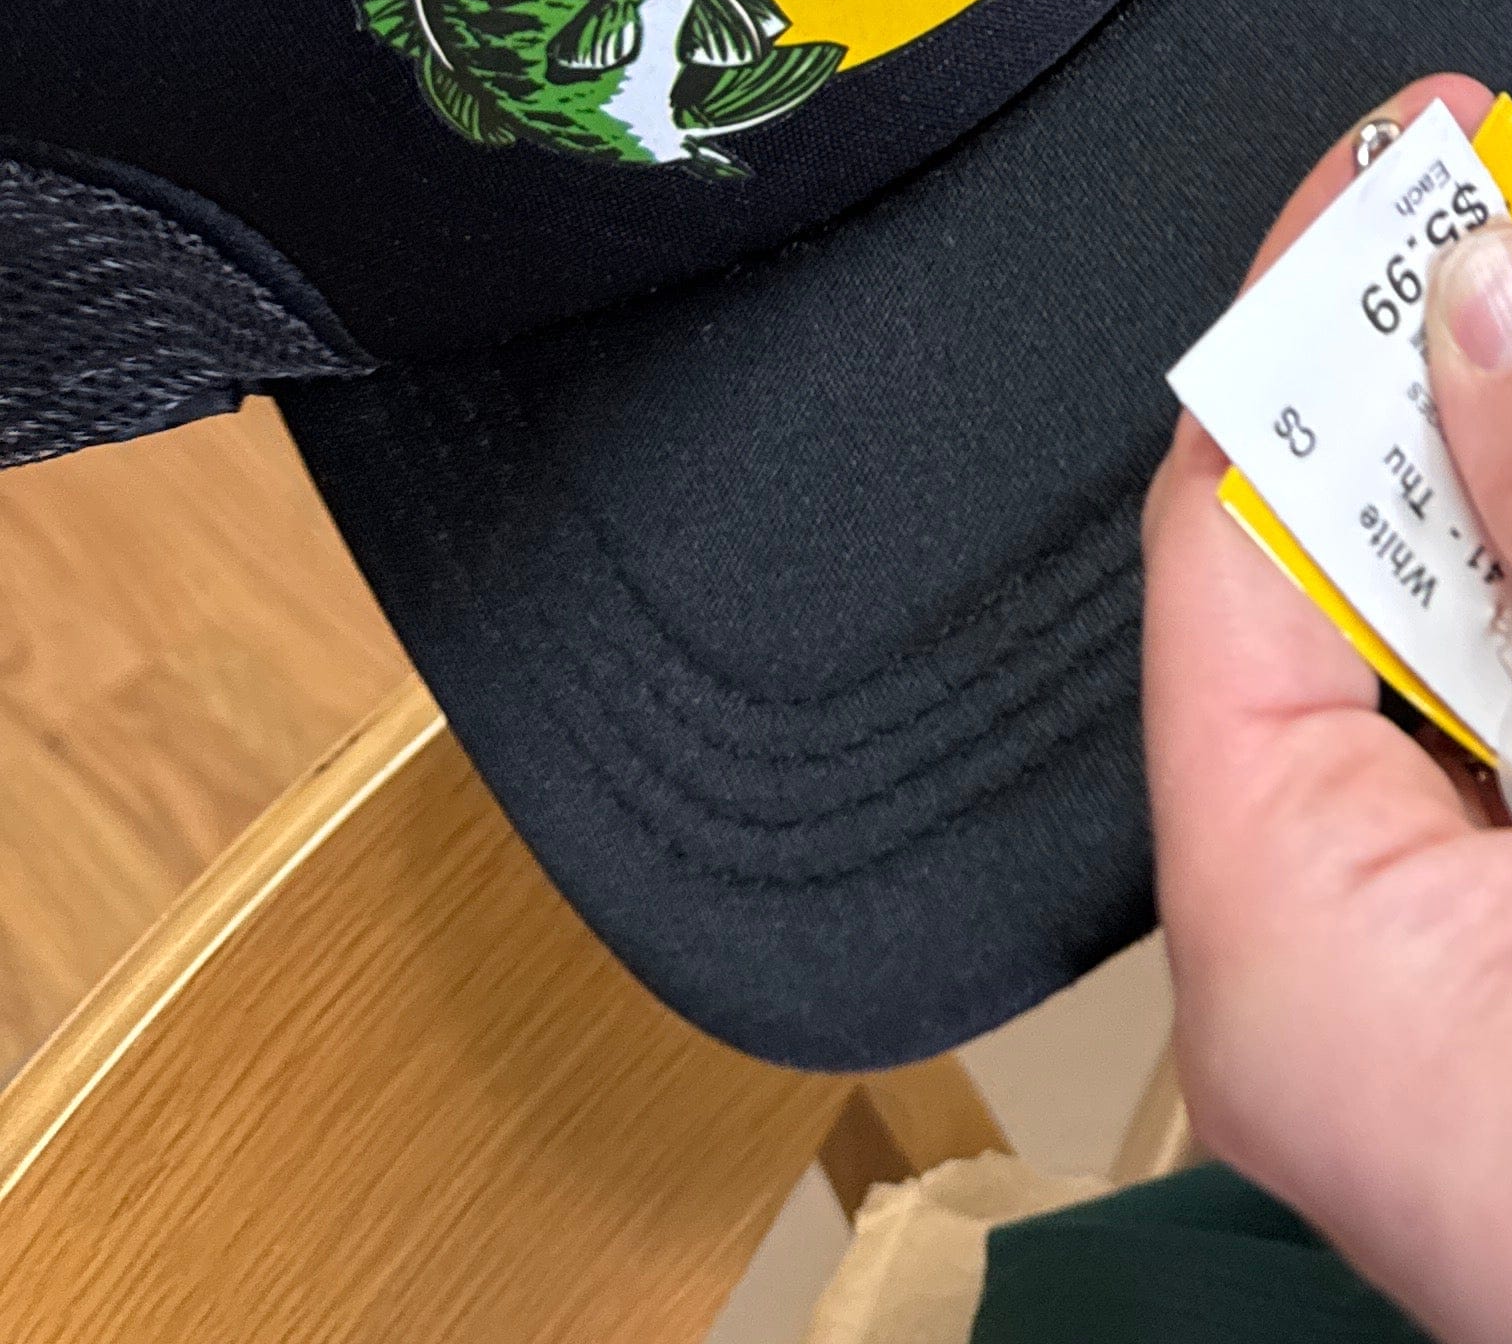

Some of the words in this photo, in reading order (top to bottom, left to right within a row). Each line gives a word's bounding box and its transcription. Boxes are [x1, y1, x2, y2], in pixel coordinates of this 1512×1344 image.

[1394, 159, 1451, 217] Each
[1361, 181, 1489, 335] $5.99
[1274, 405, 1316, 458] CS
[1383, 444, 1434, 520] Thu
[1359, 503, 1437, 608] White
